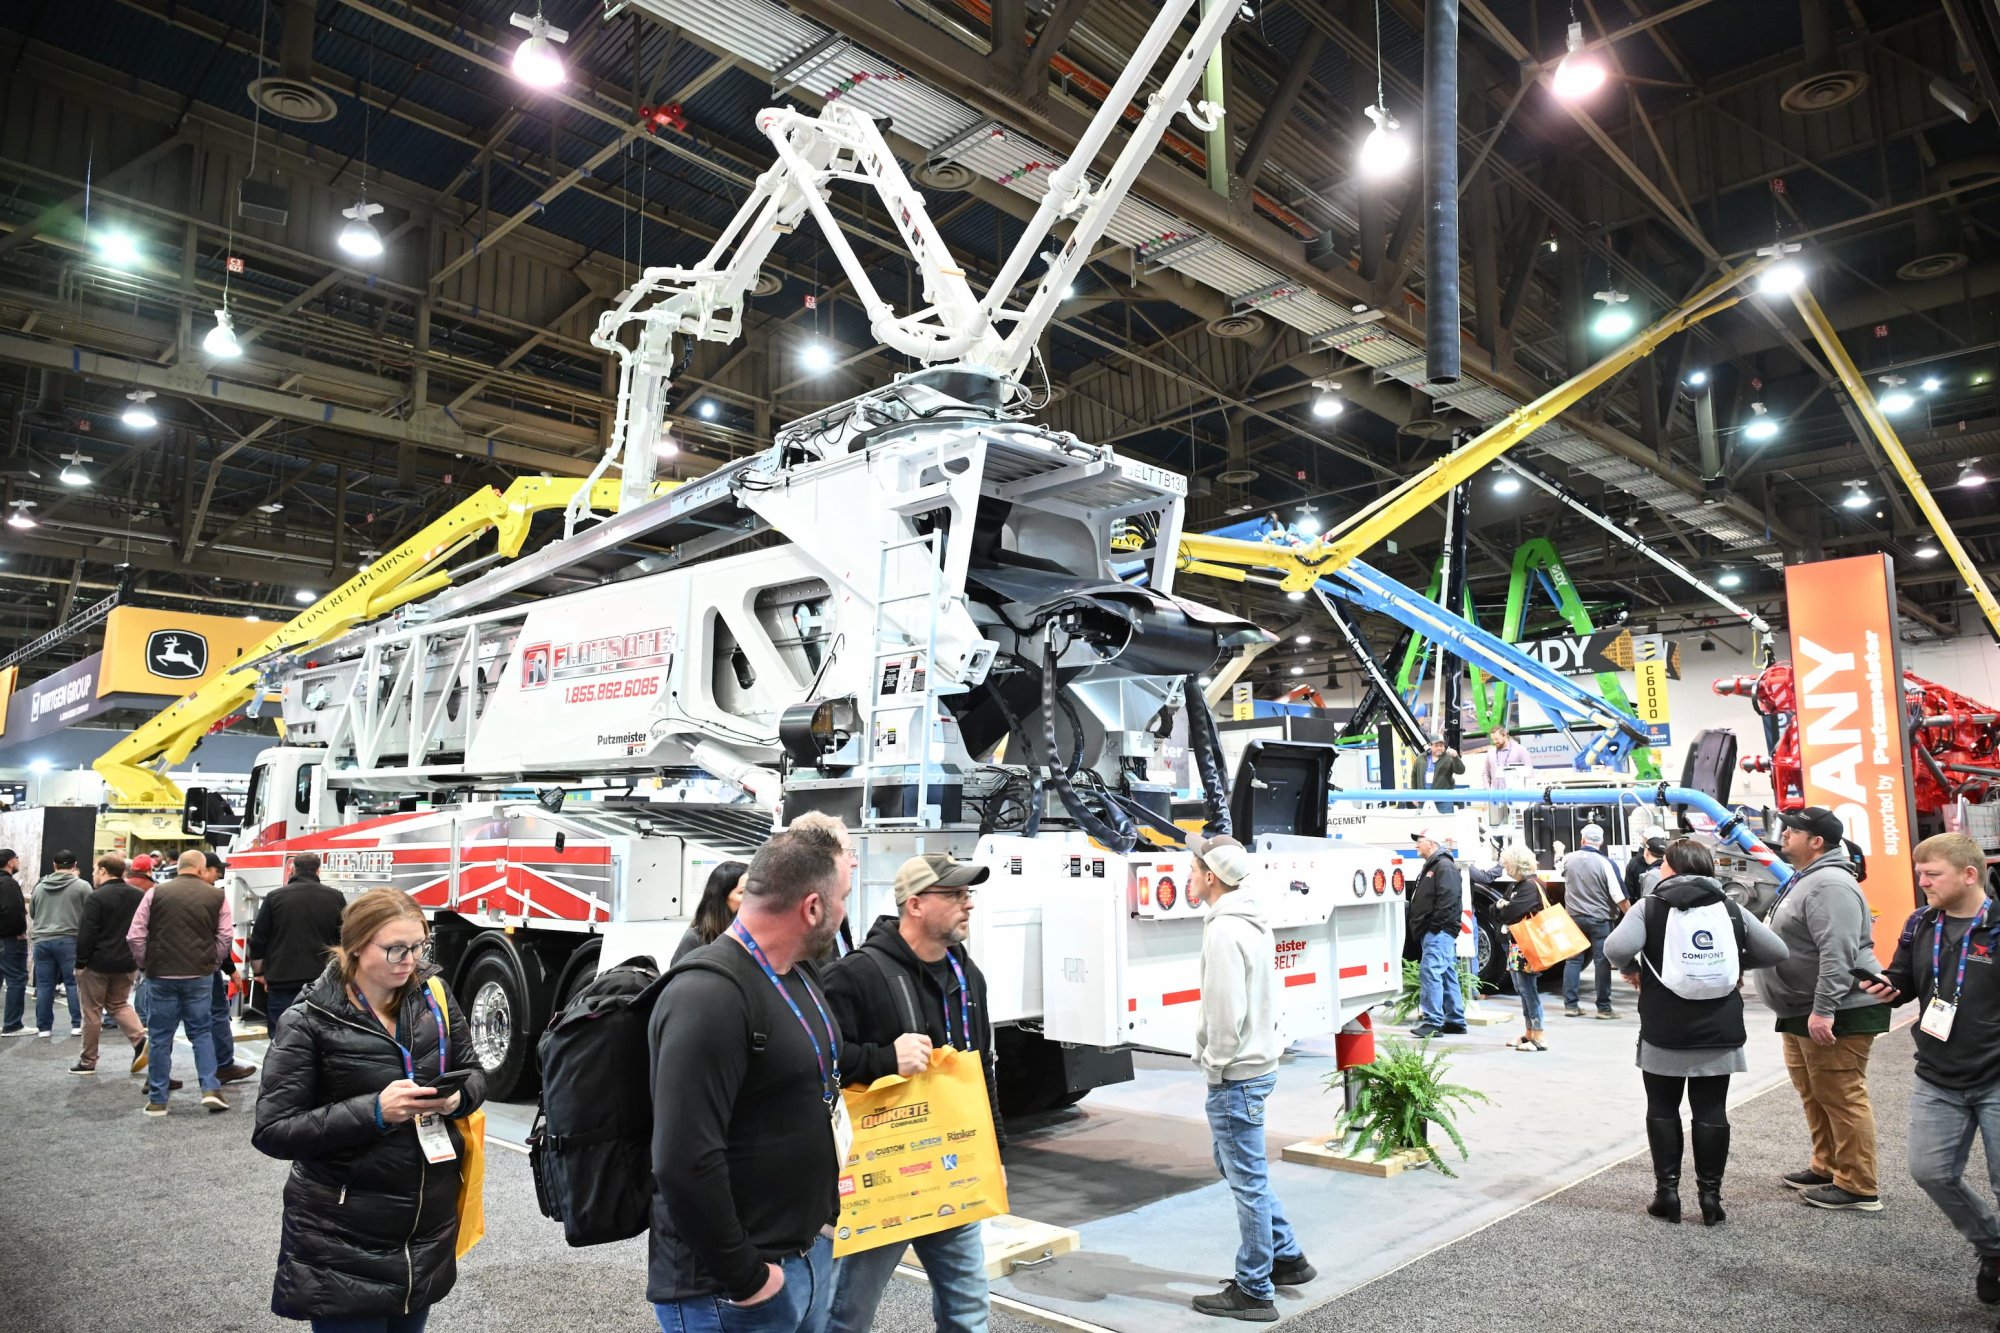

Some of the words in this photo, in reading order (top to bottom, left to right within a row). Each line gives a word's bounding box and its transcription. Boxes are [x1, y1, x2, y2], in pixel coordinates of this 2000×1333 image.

[553, 627, 675, 669] FLATRATE
[600, 663, 616, 673] INC.
[67, 673, 92, 704] GROUP
[565, 676, 660, 704] 1.855.862.6085
[1864, 629, 1890, 765] Putzmeister
[597, 732, 647, 747] Putzmeister
[1527, 744, 1569, 754] OLUTION
[1876, 774, 1895, 789] by
[1878, 790, 1900, 856] supported
[320, 851, 395, 873] LATRATE
[1682, 952, 1724, 960] COMIPONT
[862, 1101, 931, 1129] QUIKRETE
[874, 1106, 887, 1114] THE
[890, 1116, 928, 1129] COMPANIES
[947, 1128, 977, 1142] Rinker
[875, 1143, 905, 1156] CUSTOM
